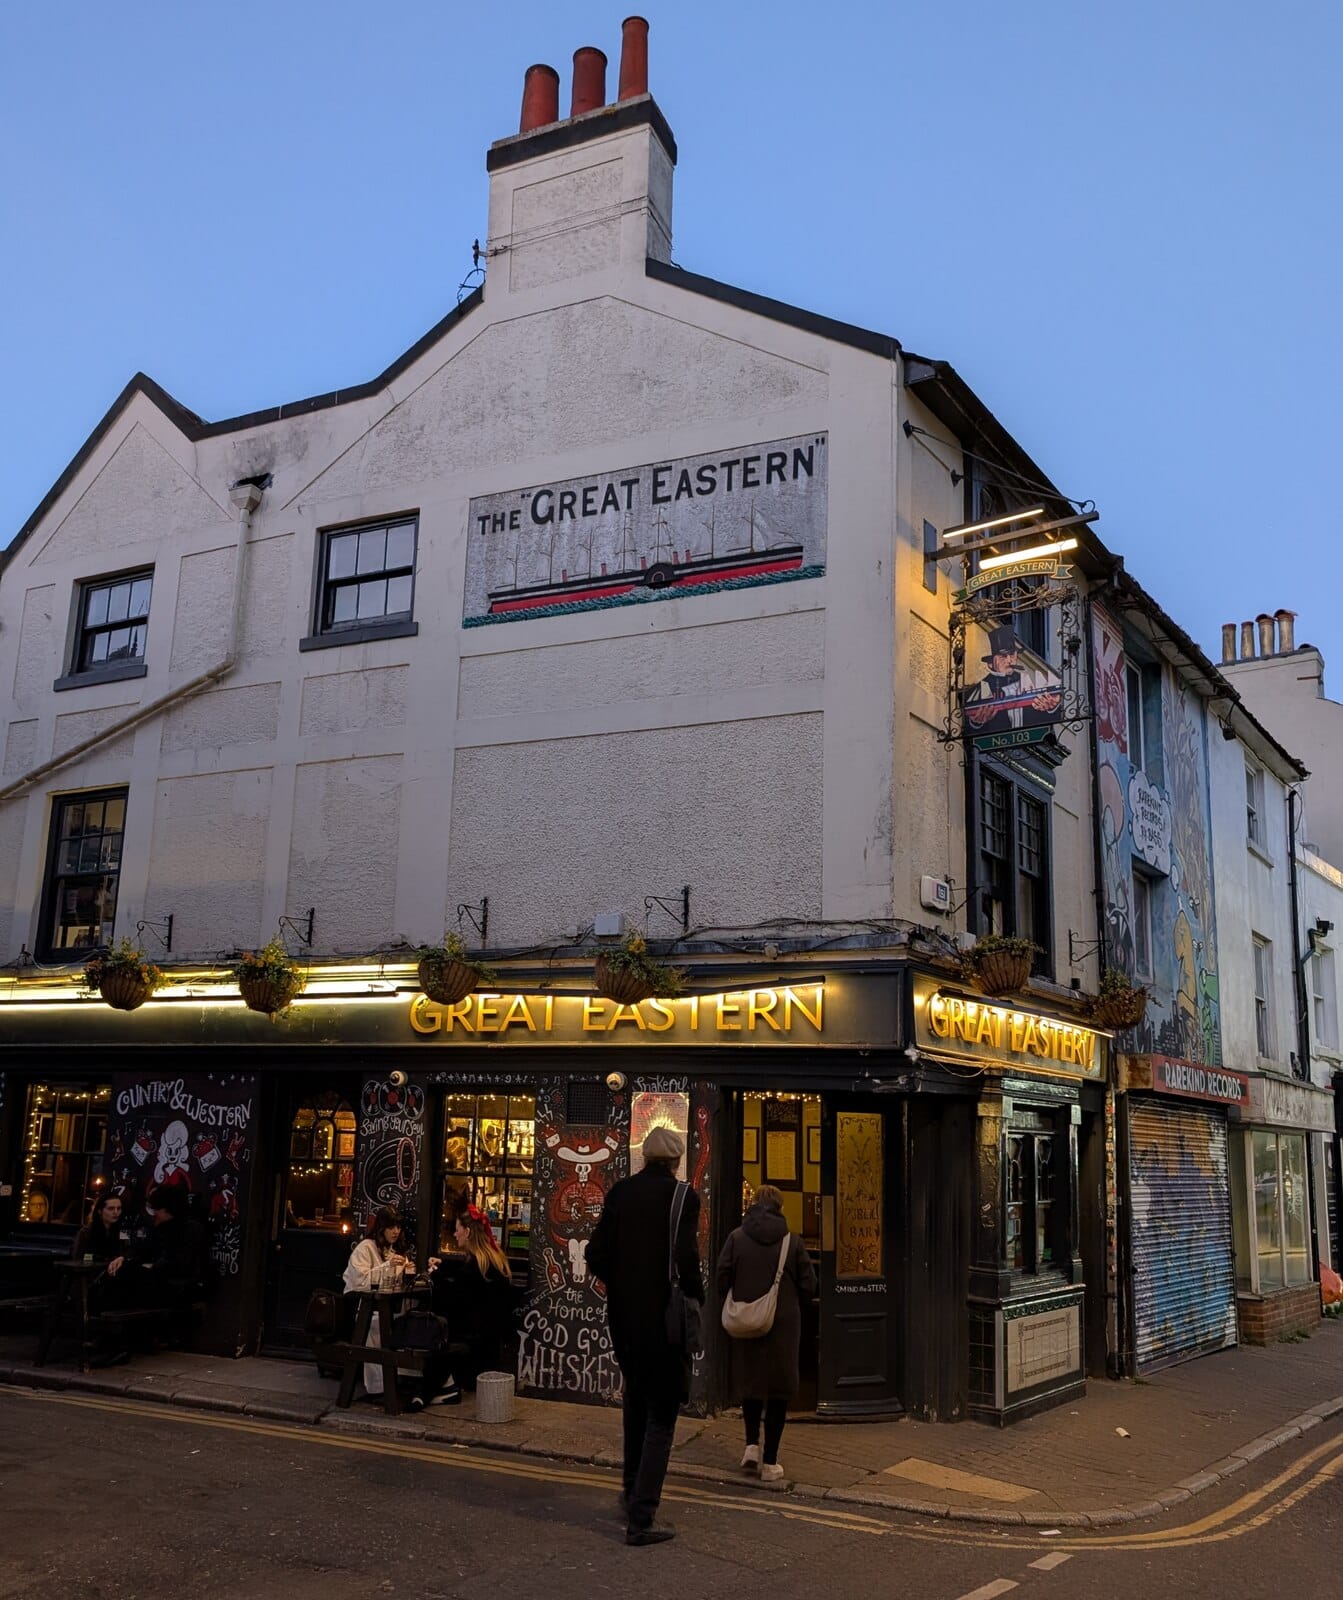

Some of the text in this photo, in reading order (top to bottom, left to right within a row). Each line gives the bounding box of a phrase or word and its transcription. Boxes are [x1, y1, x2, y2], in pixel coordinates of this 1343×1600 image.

[478, 510, 521, 535] THE
[971, 561, 1054, 588] GREAT EASTERN
[1012, 731, 1030, 743] 103
[409, 987, 824, 1034] GREAT EASTERN
[931, 994, 1001, 1048] GREAT
[1165, 1061, 1242, 1101] RAREKIND RECORDS
[186, 1094, 252, 1129] WESTERN
[849, 1226, 873, 1238] BAR
[547, 1297, 596, 1322] Home
[596, 1303, 608, 1323] of
[524, 1310, 568, 1348] GOOD
